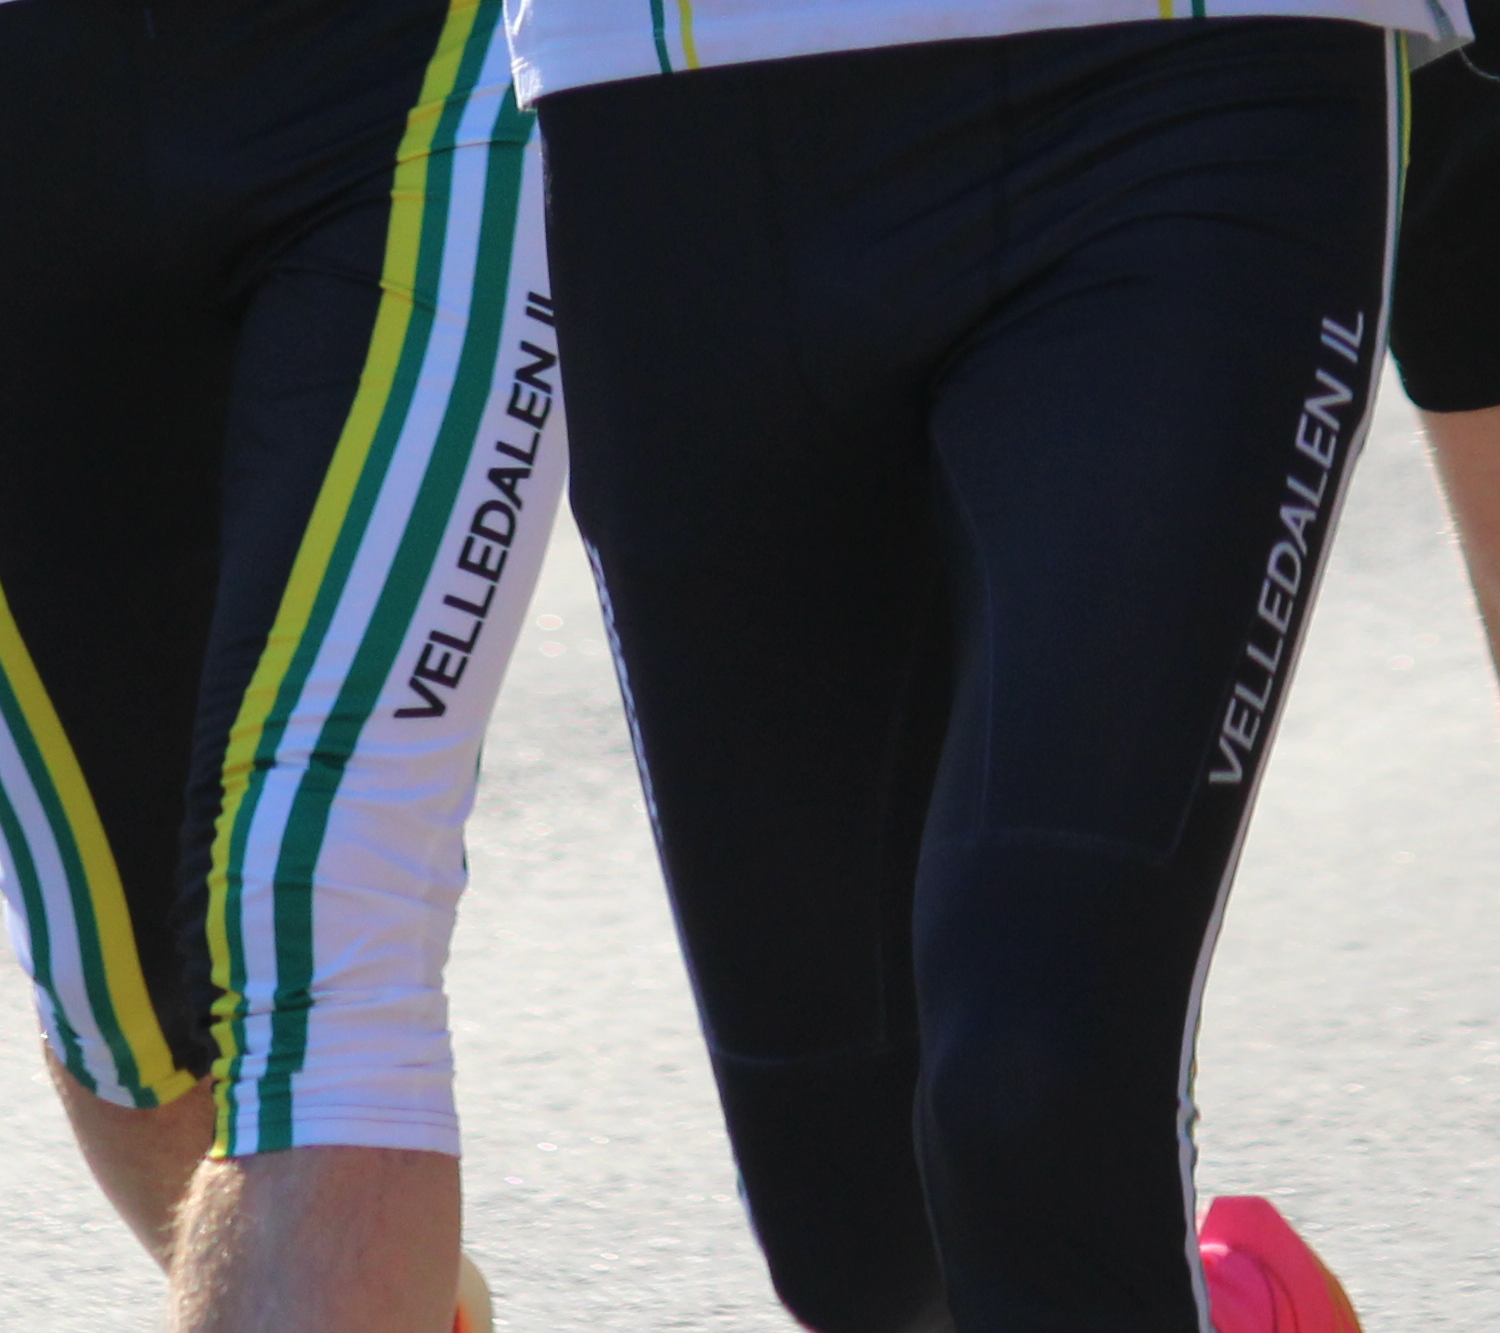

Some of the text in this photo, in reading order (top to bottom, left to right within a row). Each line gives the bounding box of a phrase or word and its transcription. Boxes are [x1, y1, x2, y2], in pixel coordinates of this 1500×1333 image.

[394, 340, 558, 720] VELLEDALEN
[1208, 311, 1364, 784] VELLEDALEN IL
